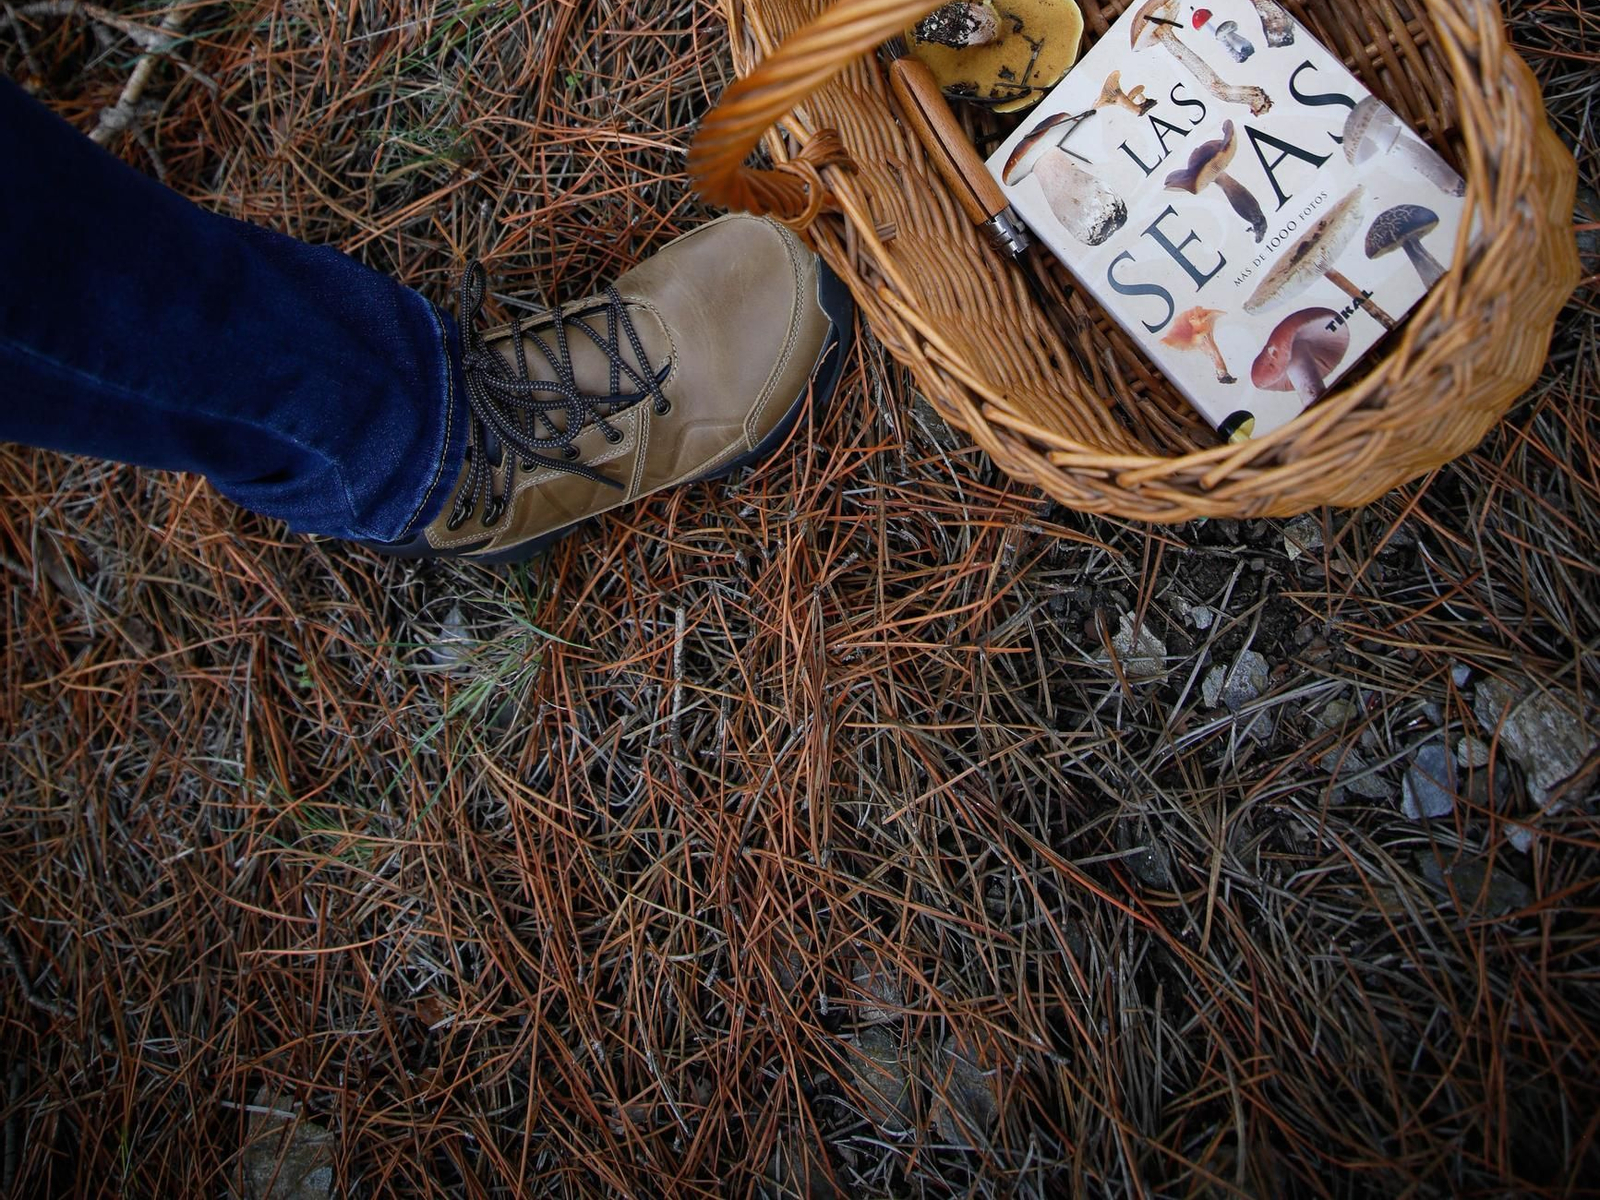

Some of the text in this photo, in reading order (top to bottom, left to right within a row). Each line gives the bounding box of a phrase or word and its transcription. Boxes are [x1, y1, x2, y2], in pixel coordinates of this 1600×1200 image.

[1118, 82, 1207, 178] LAS
[1253, 254, 1267, 267] DE
[1266, 220, 1297, 252] 1000
[1298, 191, 1328, 220] FOTOS
[1325, 289, 1374, 332] TIKAL
